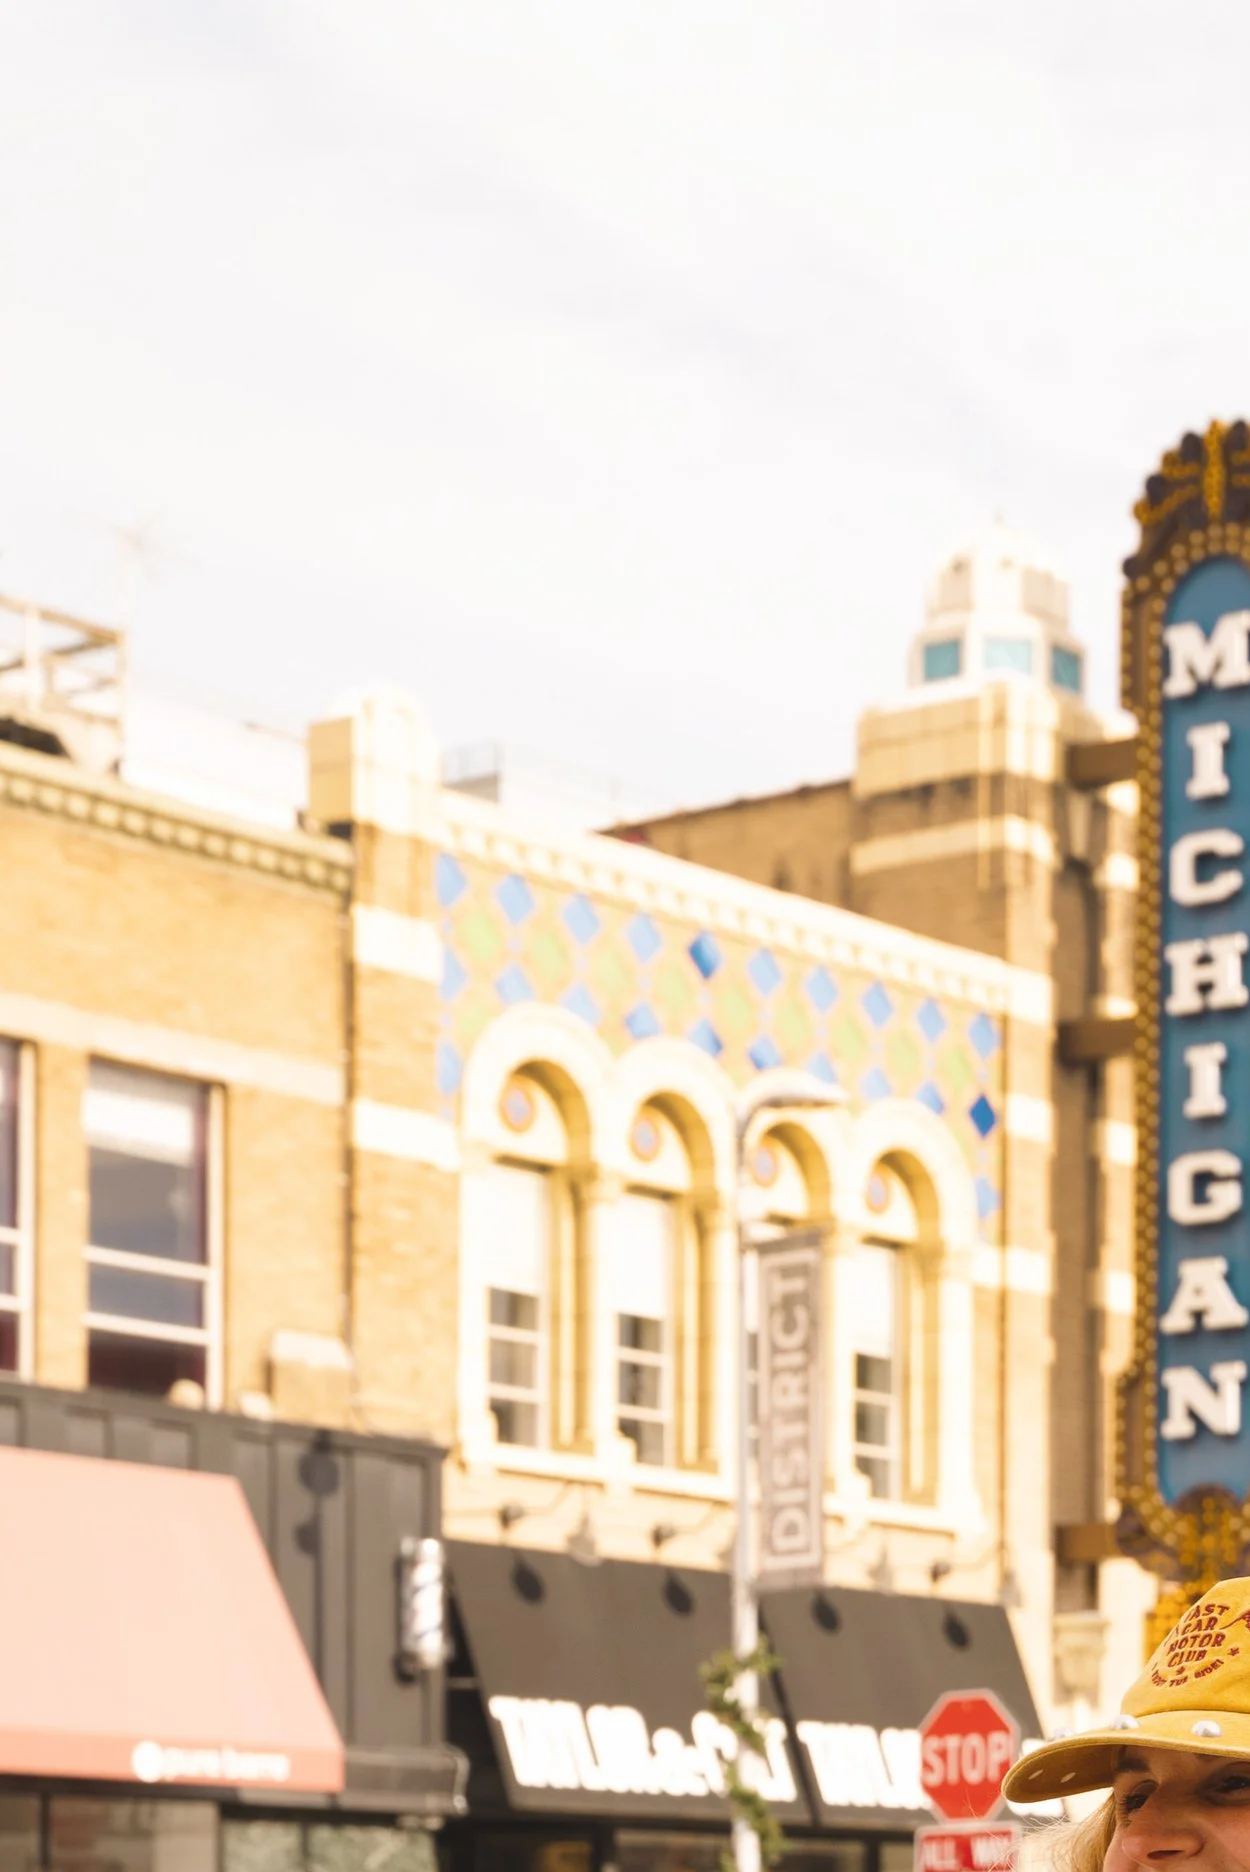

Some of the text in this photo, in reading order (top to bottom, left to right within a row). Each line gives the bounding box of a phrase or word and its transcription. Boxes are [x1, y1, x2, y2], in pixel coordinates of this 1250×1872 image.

[771, 1268, 810, 1555] DISTRICT
[1182, 1616, 1219, 1636] CAR
[1168, 1633, 1226, 1655] MOTOR
[1168, 1650, 1208, 1668] CLUB
[923, 1730, 1012, 1786] STOP
[921, 1836, 959, 1872] ALL
